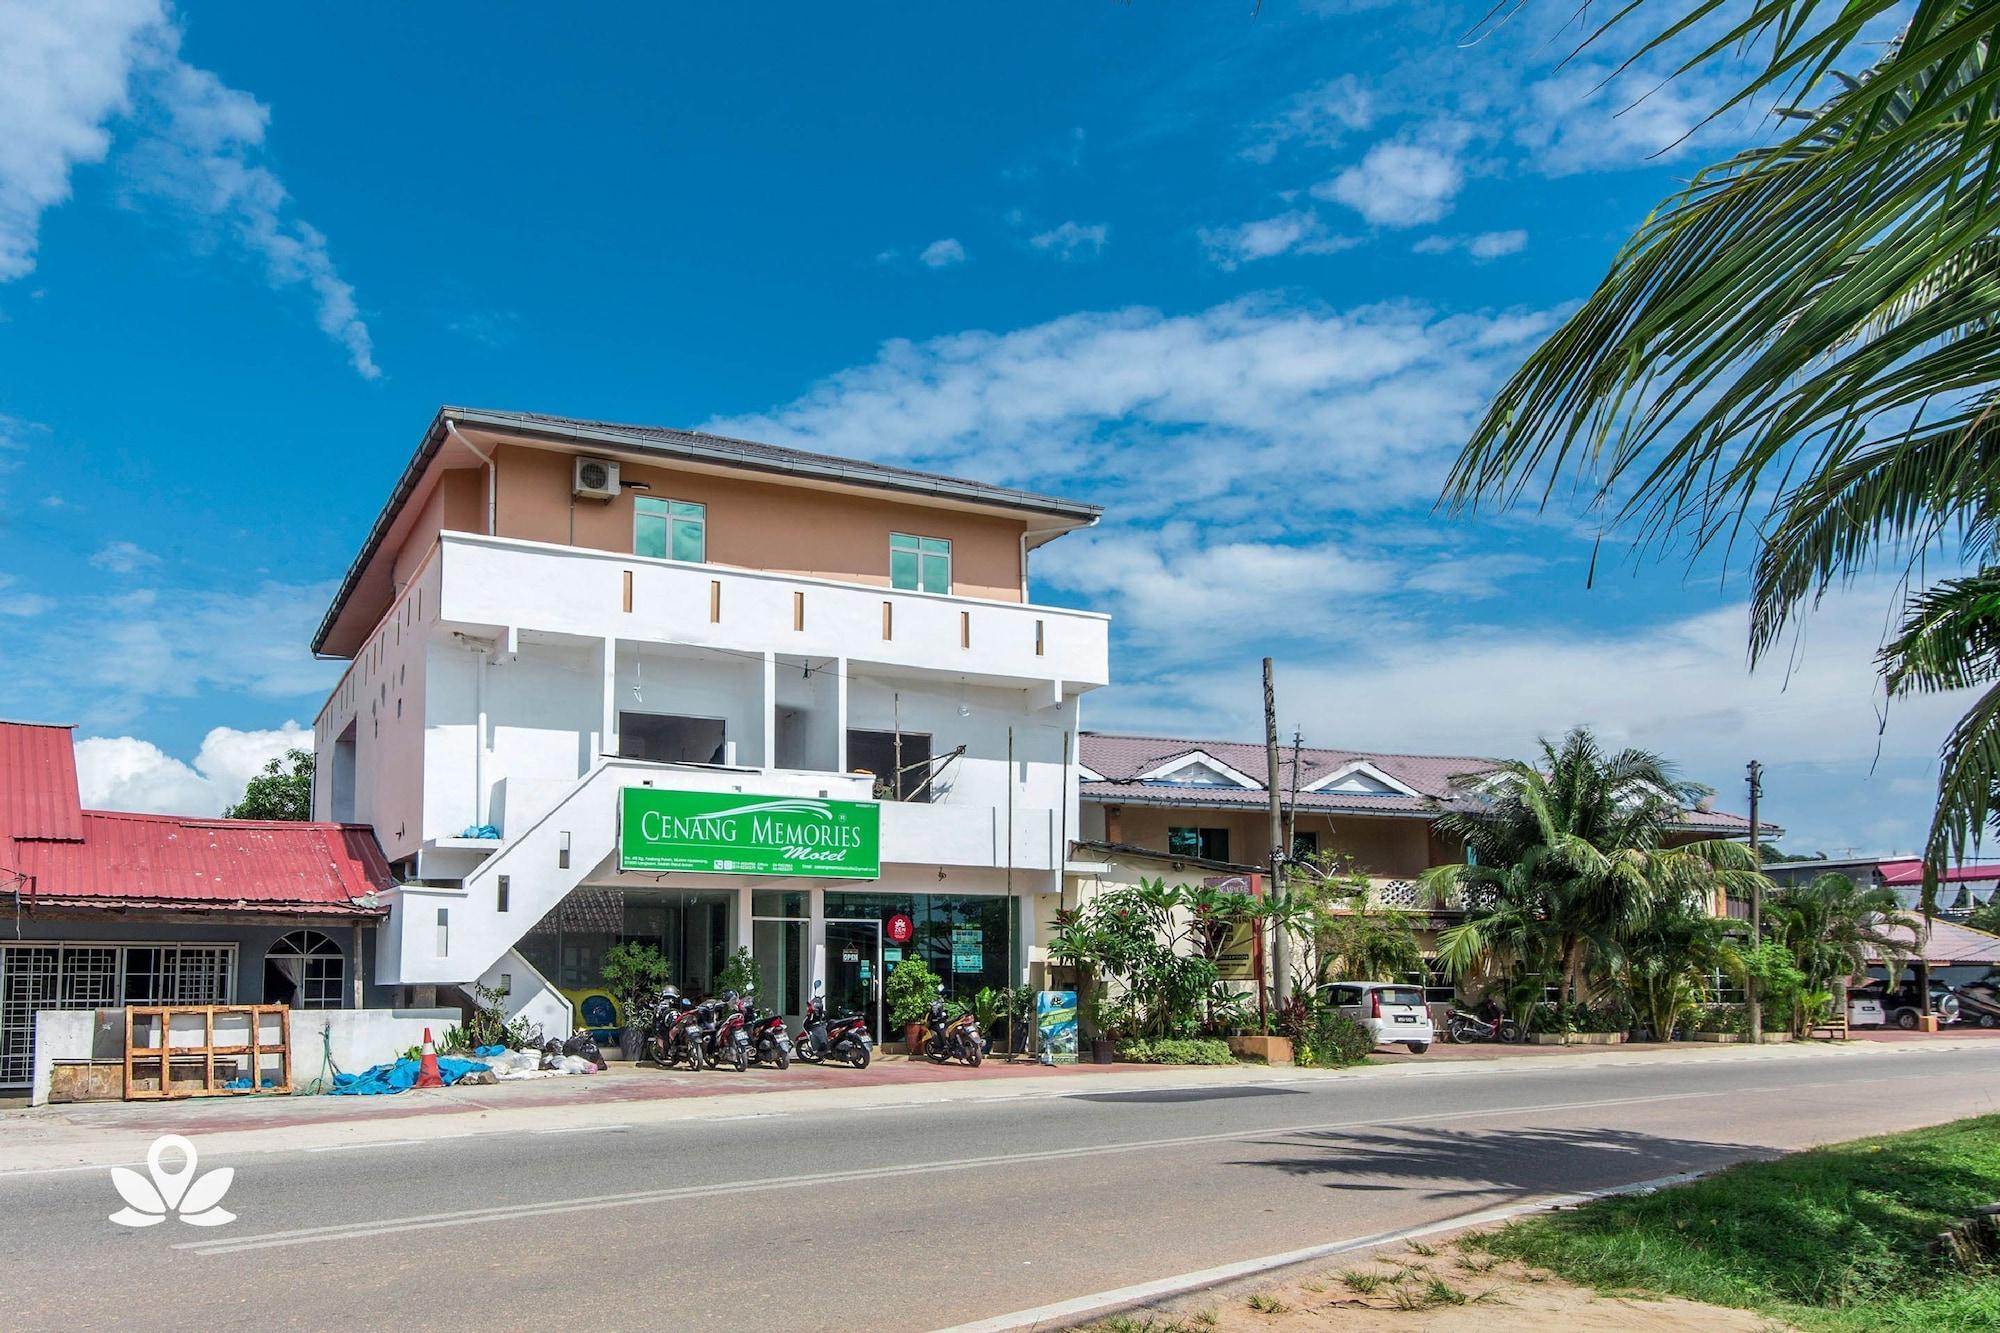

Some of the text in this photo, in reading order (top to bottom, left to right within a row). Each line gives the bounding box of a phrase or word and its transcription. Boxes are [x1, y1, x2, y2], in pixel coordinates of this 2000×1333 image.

[642, 811, 861, 848] CENANG MEMORIES
[781, 845, 847, 862] Motel
[843, 953, 858, 961] OPEN
